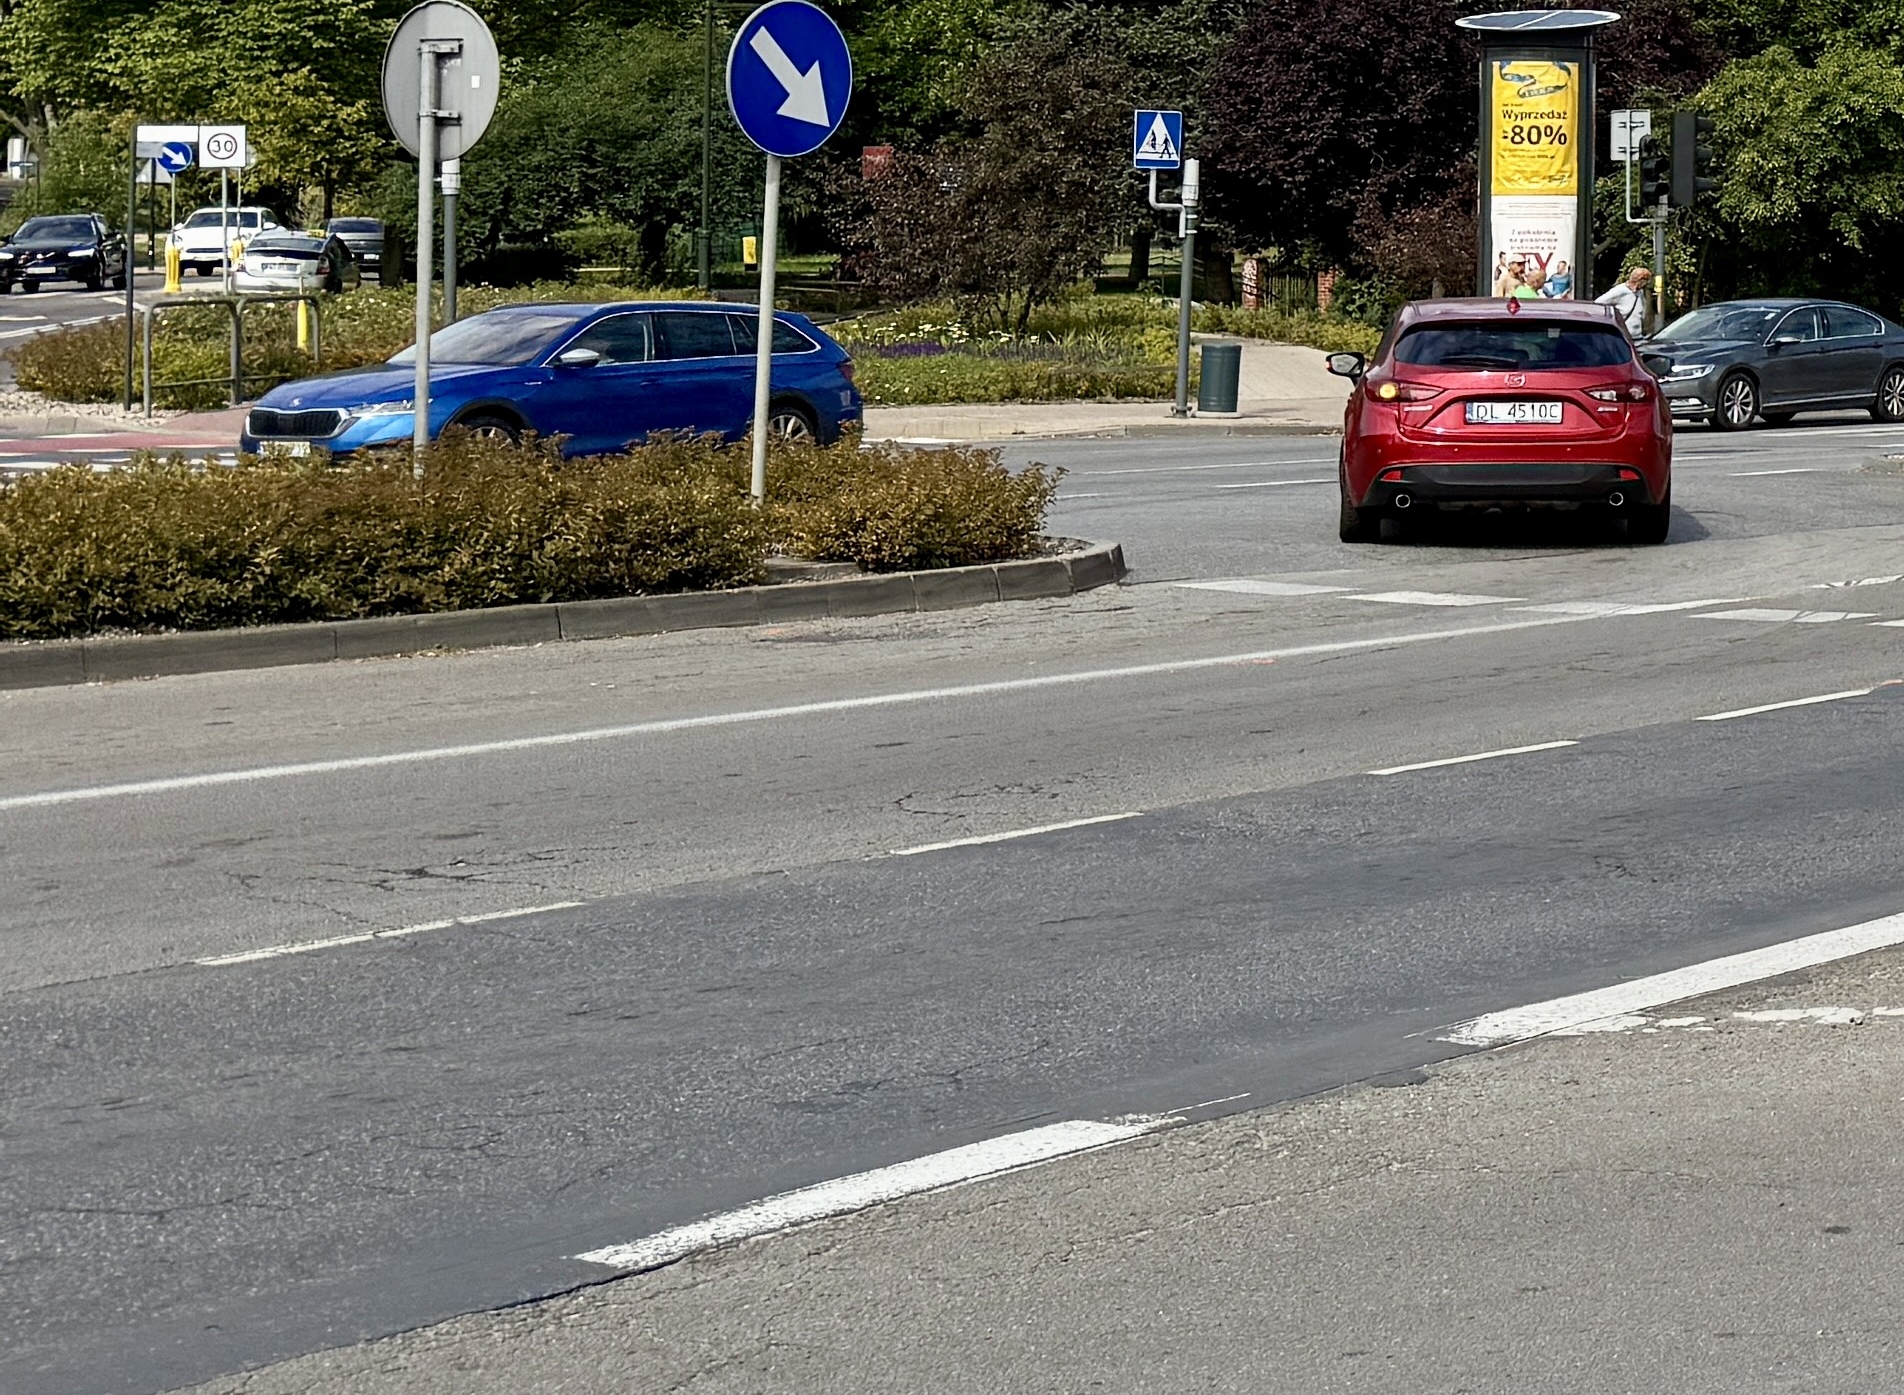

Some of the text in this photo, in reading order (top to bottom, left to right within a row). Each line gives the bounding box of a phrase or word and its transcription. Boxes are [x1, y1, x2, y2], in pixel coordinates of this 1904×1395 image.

[211, 139, 234, 154] 30
[1476, 404, 1560, 419] DL 4510C
